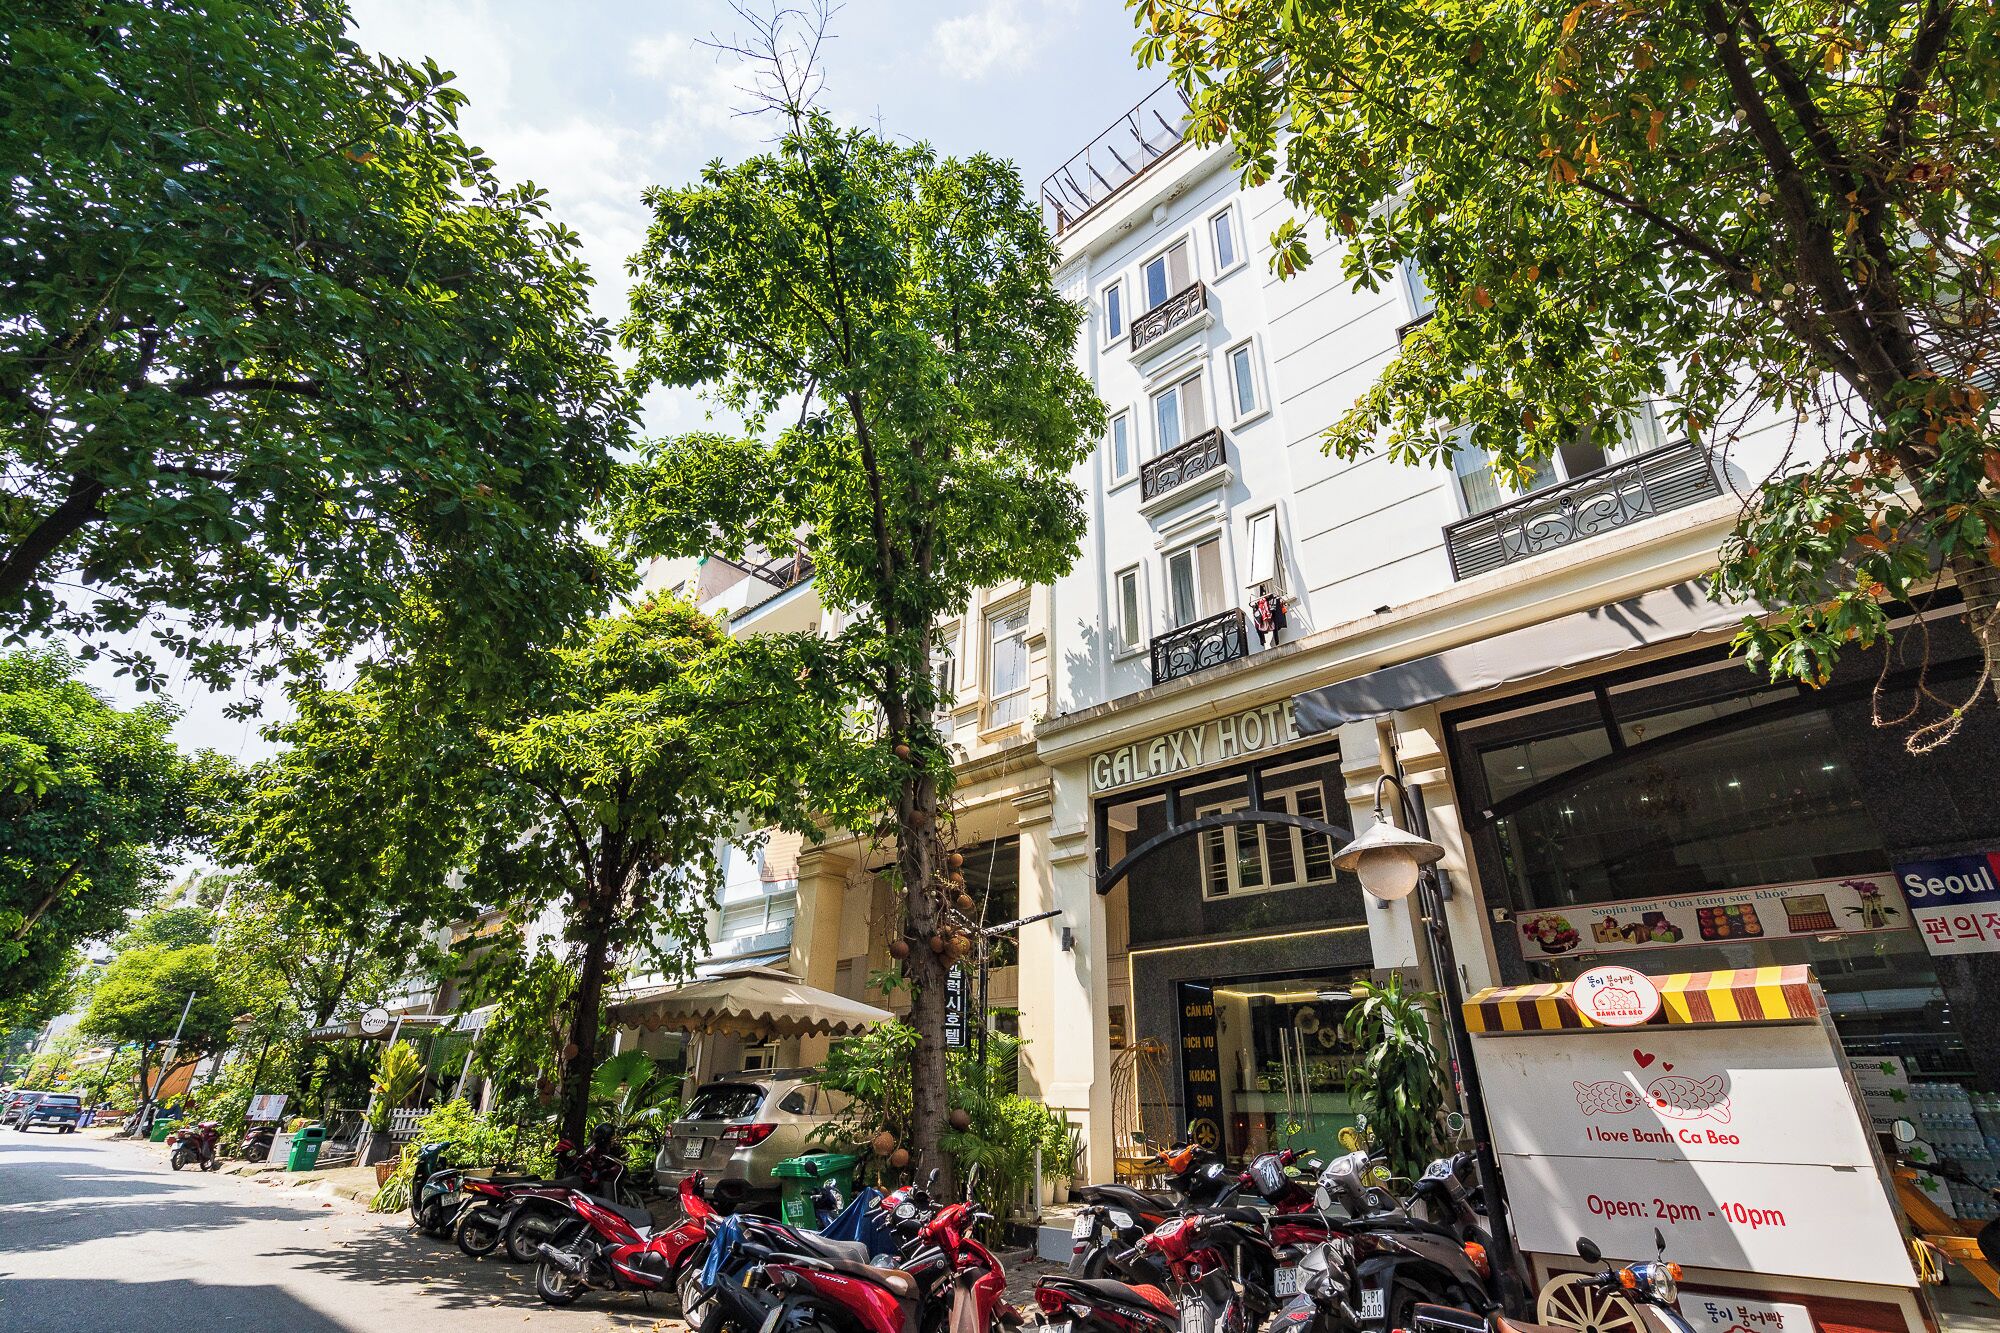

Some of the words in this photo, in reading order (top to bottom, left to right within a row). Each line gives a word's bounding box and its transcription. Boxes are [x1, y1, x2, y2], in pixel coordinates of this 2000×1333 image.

[1094, 724, 1205, 790] GALAXY
[1218, 699, 1300, 759] HOTE
[1905, 867, 1994, 897] Seoul
[1591, 905, 1627, 916] Soojin
[1631, 903, 1658, 912] mart
[1586, 1127, 1593, 1141] I
[1595, 1126, 1629, 1142] love
[1632, 1127, 1675, 1144] Banh
[1678, 1128, 1702, 1144] Ca
[1706, 1130, 1740, 1145] Beo
[1587, 1194, 1648, 1219] Open:
[1653, 1198, 1701, 1224] 2pm
[1721, 1202, 1786, 1229] 10pm
[1277, 1281, 1297, 1293] 470.8
[1361, 1304, 1382, 1317] 38.09
[1737, 1306, 1785, 1330] 붕어빵
